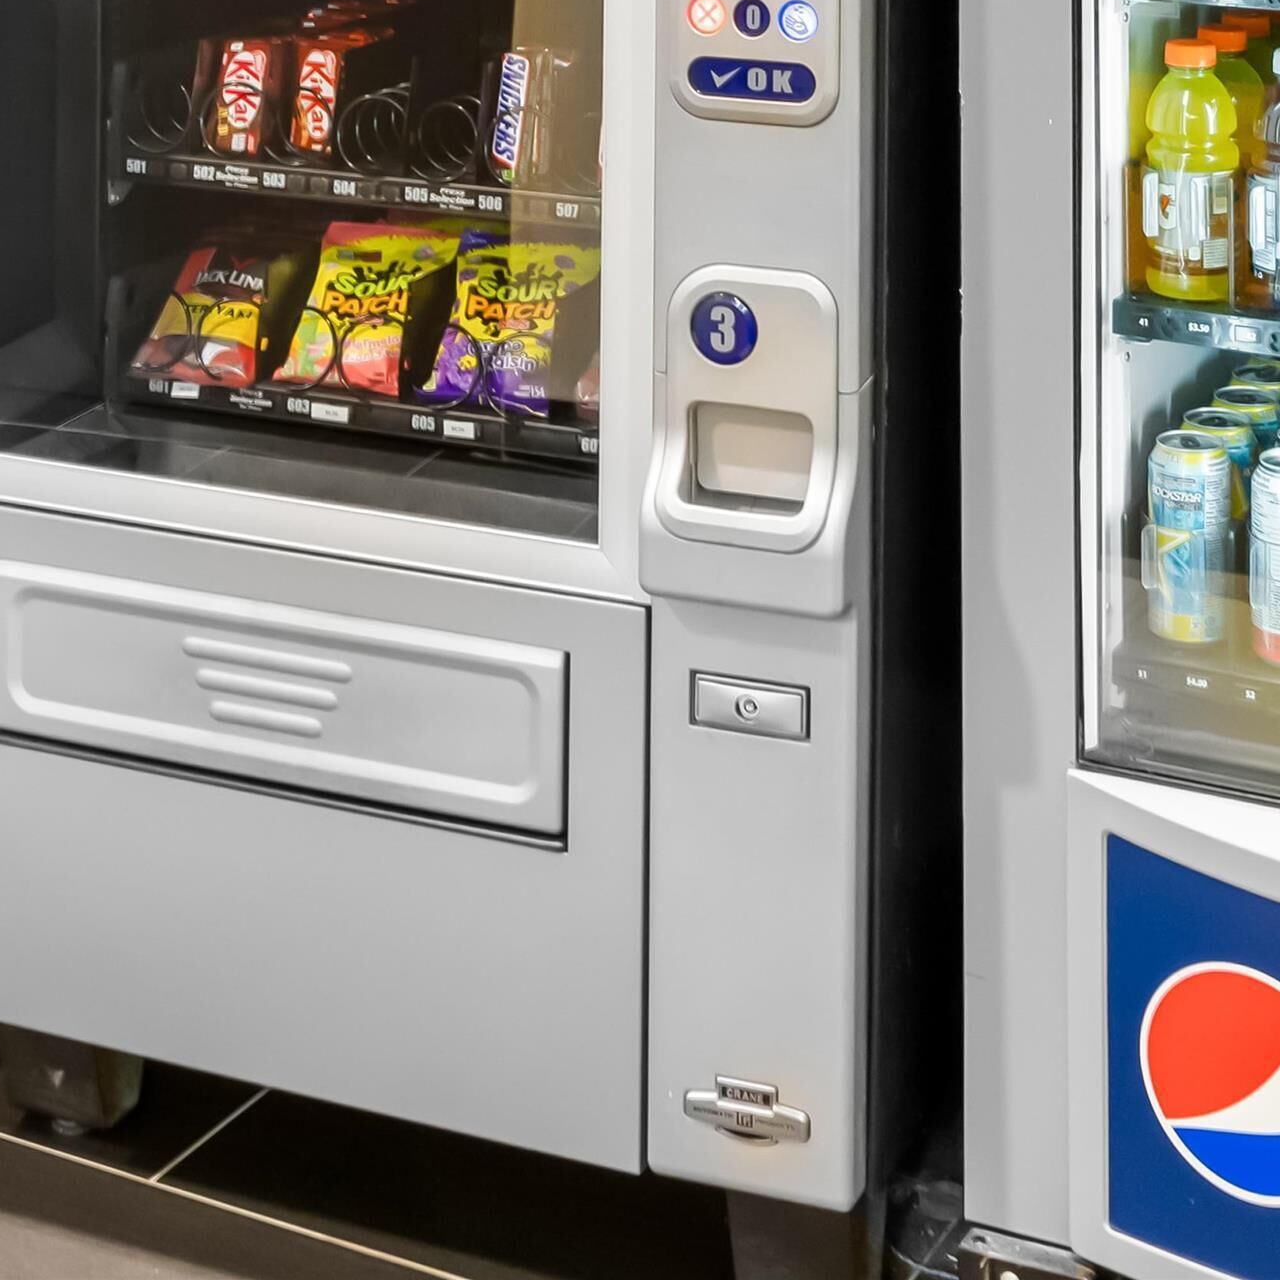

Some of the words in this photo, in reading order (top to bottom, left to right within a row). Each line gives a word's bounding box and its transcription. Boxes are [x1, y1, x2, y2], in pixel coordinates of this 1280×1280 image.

[745, 4, 761, 30] 0
[747, 67, 793, 94] OK
[494, 55, 528, 162] SNICKERS
[126, 158, 147, 174] 501
[193, 165, 215, 181] 502
[263, 172, 286, 189] 503
[333, 180, 356, 196] 504
[405, 186, 428, 203] 505
[478, 195, 502, 211] 506
[556, 203, 578, 218] 507
[334, 271, 411, 299] SOUR
[477, 278, 560, 303] SOUR
[322, 289, 409, 314] PATCH
[466, 294, 556, 321] PATCH
[710, 305, 737, 354] 3
[1138, 317, 1148, 326] 41
[1188, 323, 1210, 334] $3.50
[287, 397, 310, 414] 603
[412, 414, 436, 432] 605
[1186, 677, 1208, 689] $4.00
